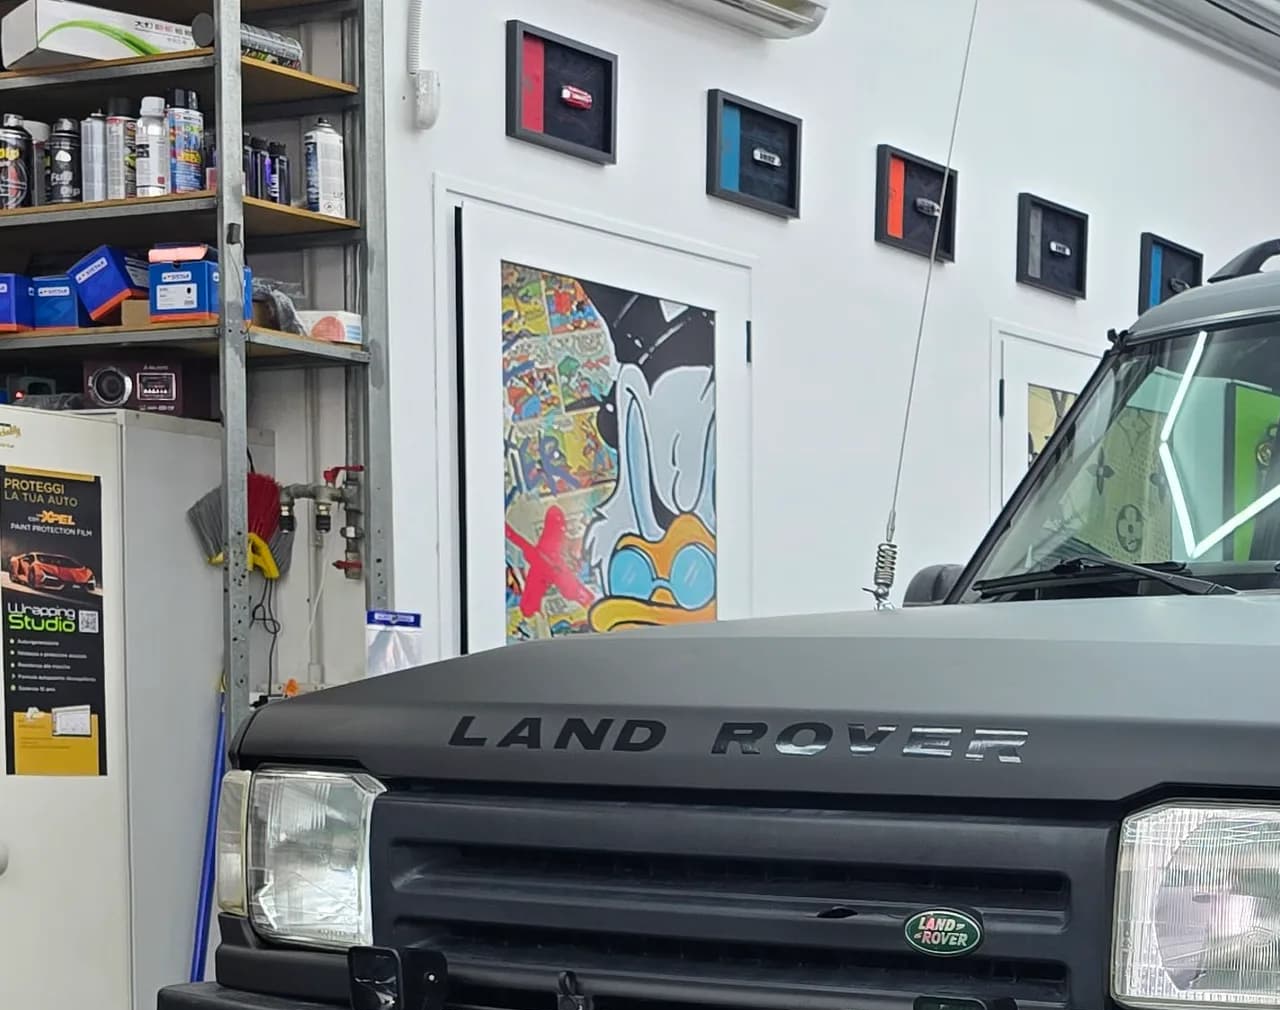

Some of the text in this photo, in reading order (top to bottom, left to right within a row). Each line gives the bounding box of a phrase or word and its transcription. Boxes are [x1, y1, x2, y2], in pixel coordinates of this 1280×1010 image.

[4, 478, 65, 495] PROTEGGI
[4, 490, 79, 508] LA TUA AUTO
[36, 510, 76, 526] XPEL
[10, 522, 93, 537] PAINT PROTECTION FILM
[7, 602, 76, 621] Wrapping
[8, 614, 76, 633] Studio
[447, 715, 1029, 763] LAND ROVER
[918, 916, 956, 932] LAND
[921, 930, 969, 947] ROVER
